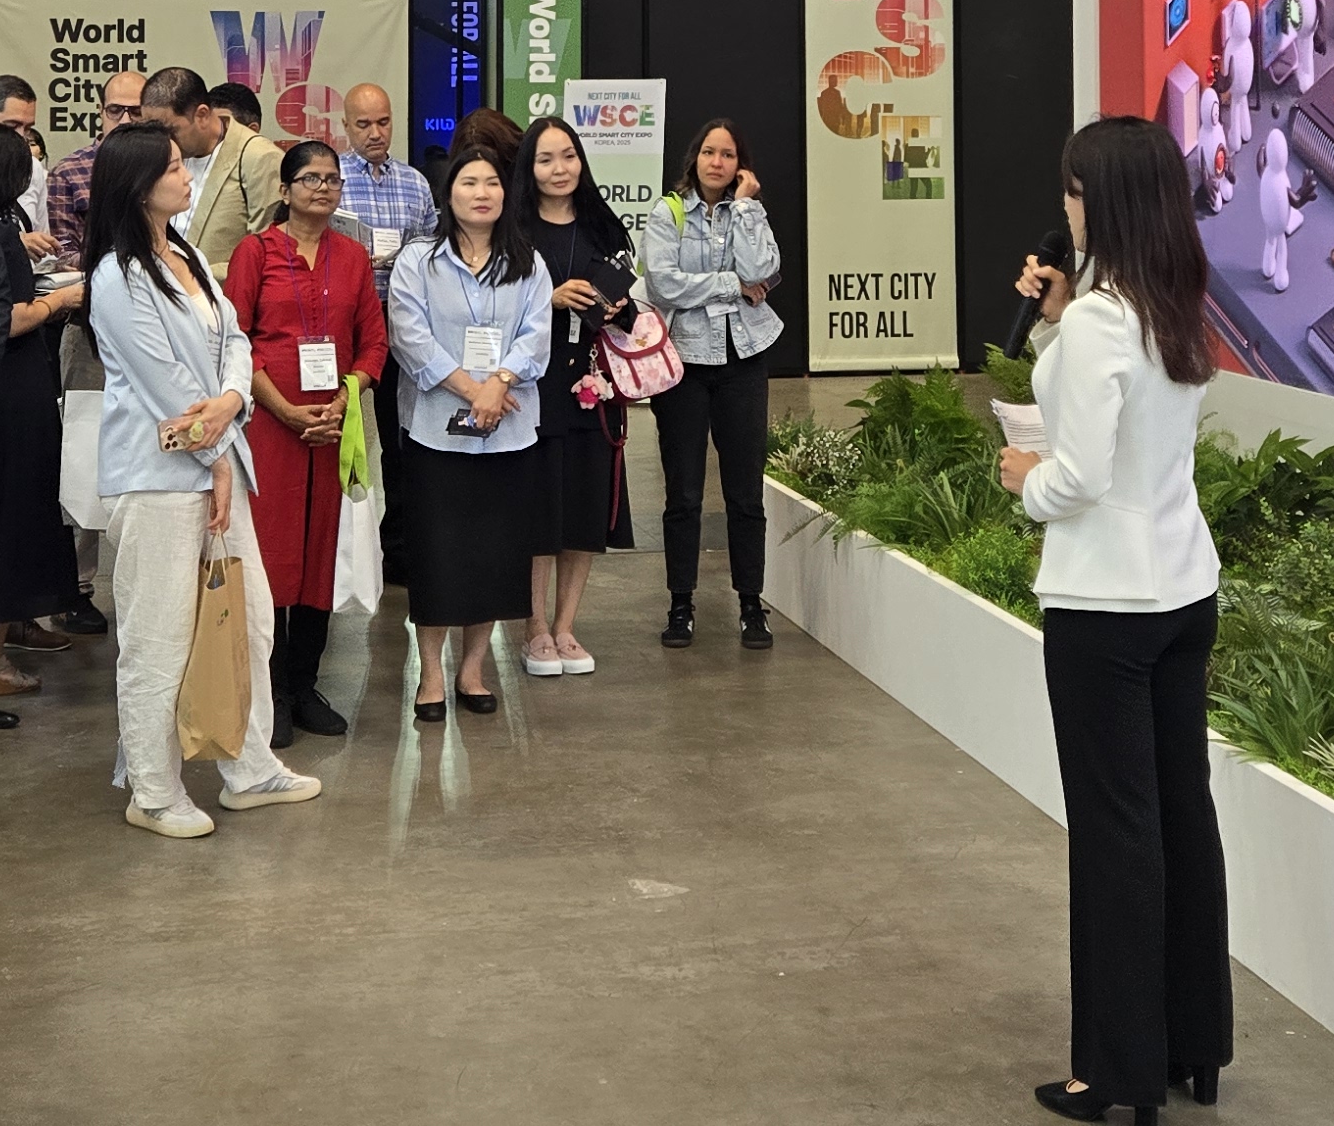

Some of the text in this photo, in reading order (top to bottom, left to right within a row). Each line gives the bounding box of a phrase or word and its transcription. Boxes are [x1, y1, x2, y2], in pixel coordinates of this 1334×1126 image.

[50, 18, 145, 43] World
[50, 48, 147, 73] Smart
[587, 92, 641, 101] NEXT CITY FOR ALL
[50, 107, 103, 138] Exp
[573, 105, 655, 127] WSCE
[597, 184, 652, 202] ORLD
[828, 272, 937, 301] NEXT CITY
[828, 310, 914, 339] FOR ALL
